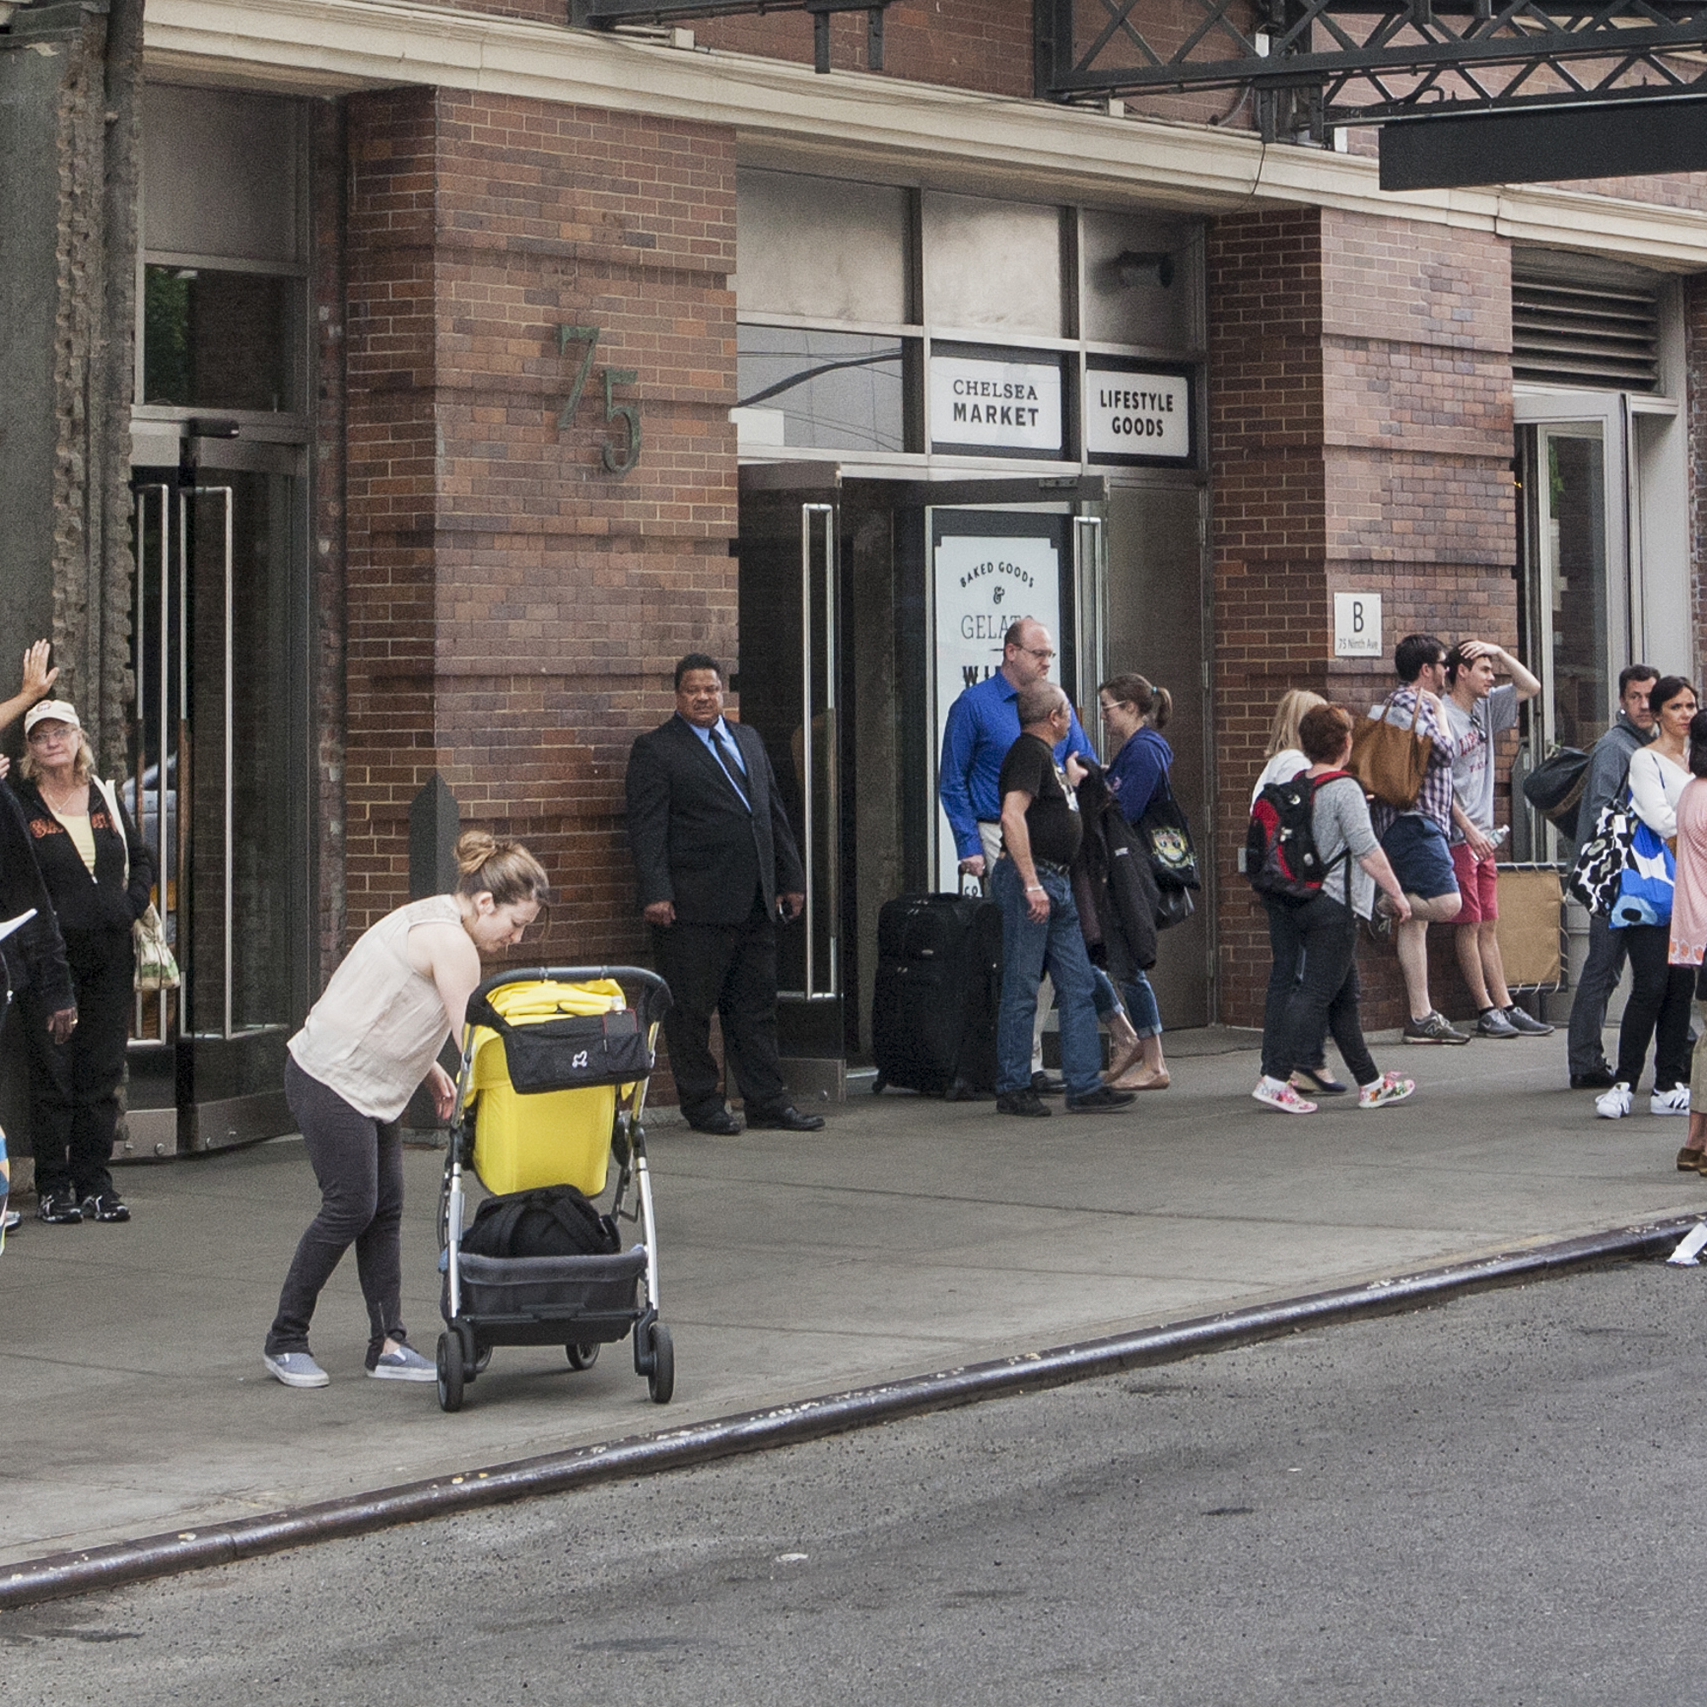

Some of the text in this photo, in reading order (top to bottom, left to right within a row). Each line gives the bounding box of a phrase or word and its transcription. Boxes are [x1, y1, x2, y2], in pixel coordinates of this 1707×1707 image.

[556, 323, 641, 477] 75
[953, 379, 1038, 401] CHELSEA
[1100, 390, 1173, 412] LIFESTYLE
[953, 402, 1039, 427] MARKET
[1111, 416, 1164, 437] GOODS
[960, 561, 1034, 588] BAKED GOODS
[993, 586, 1006, 604] &
[1353, 601, 1364, 633] B
[1339, 638, 1347, 649] 75
